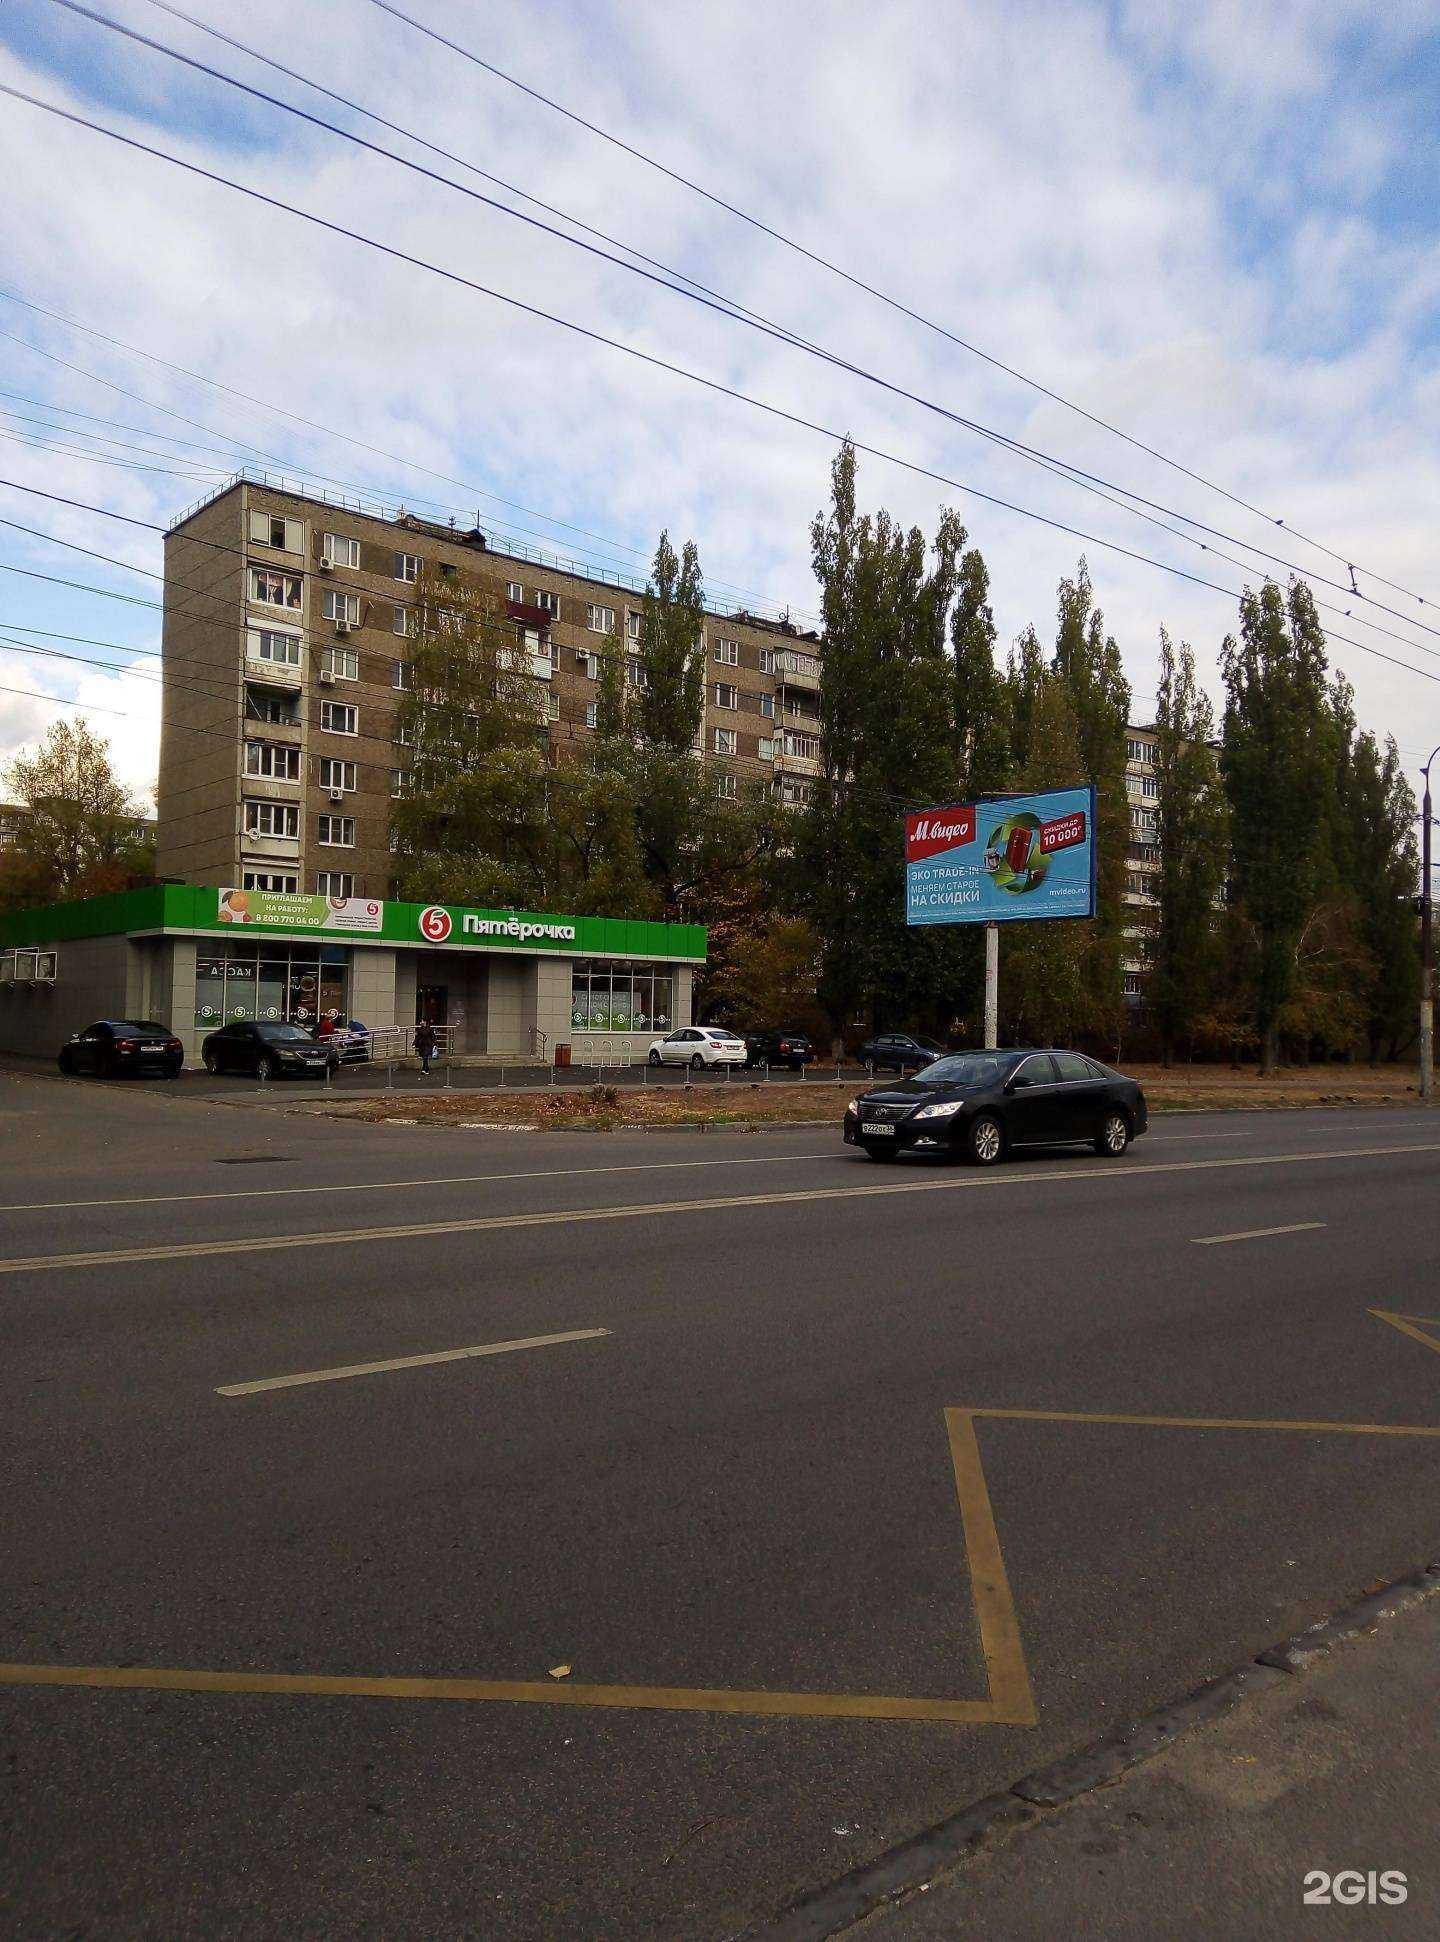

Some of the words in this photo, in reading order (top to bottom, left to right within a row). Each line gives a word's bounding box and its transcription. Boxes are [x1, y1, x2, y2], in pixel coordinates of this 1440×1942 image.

[1044, 834, 1055, 846] 10
[911, 870, 931, 881] ЭКО
[911, 883, 945, 894] МЕНЯЕМ
[946, 880, 980, 891] СТАРОЕ
[1049, 887, 1088, 896] mvideo.ru
[261, 893, 313, 904] ПРИГЛАШАЕМ
[911, 894, 928, 906] НА
[930, 889, 980, 906] СКИДКИ
[265, 904, 277, 912] НА
[256, 913, 262, 922] 8
[280, 915, 295, 924] 770
[308, 917, 320, 925] 00
[462, 914, 576, 942] Пятёрочка
